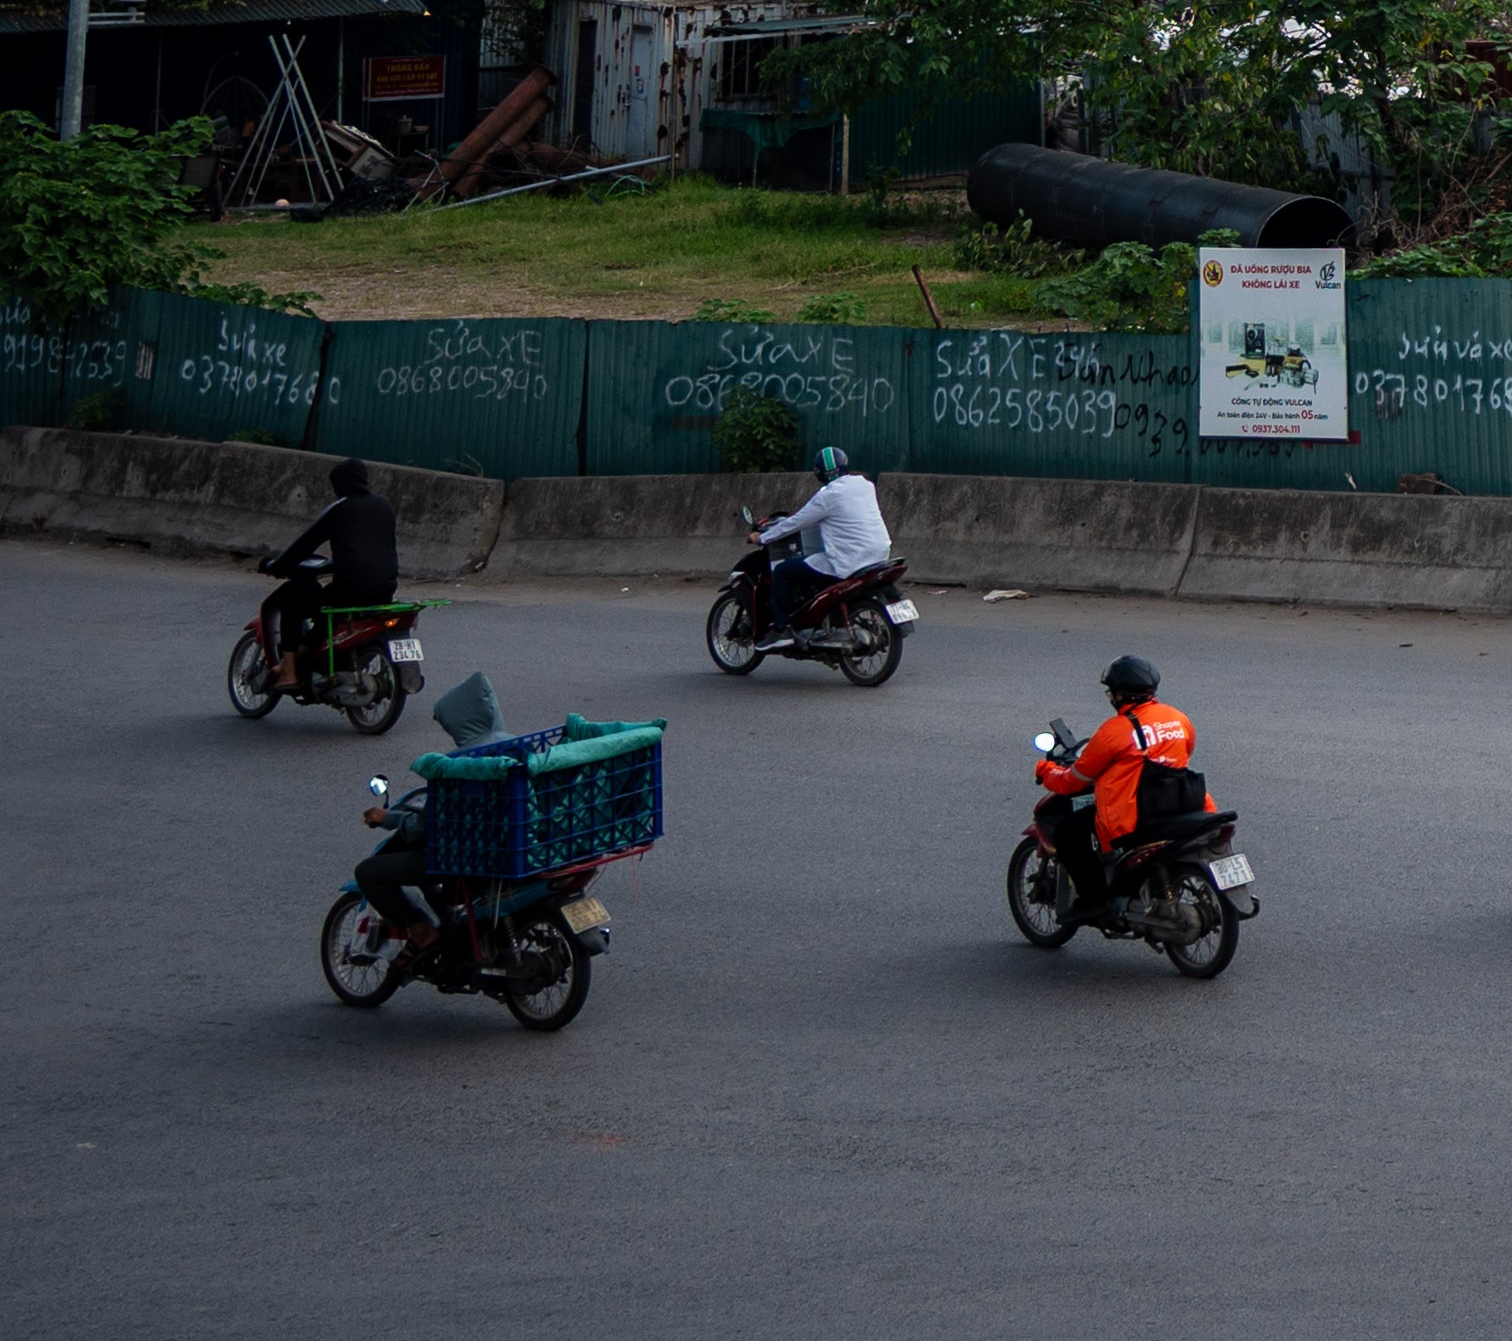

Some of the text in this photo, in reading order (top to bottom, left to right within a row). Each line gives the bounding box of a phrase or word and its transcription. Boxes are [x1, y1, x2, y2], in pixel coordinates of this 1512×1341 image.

[1242, 278, 1301, 289] KHÔNG LÁI XE
[1315, 280, 1342, 290] Vulcan
[1284, 398, 1313, 407] VULCAN
[933, 383, 1117, 439] 0862585039
[1301, 410, 1314, 420] 05
[1157, 728, 1185, 743] Food
